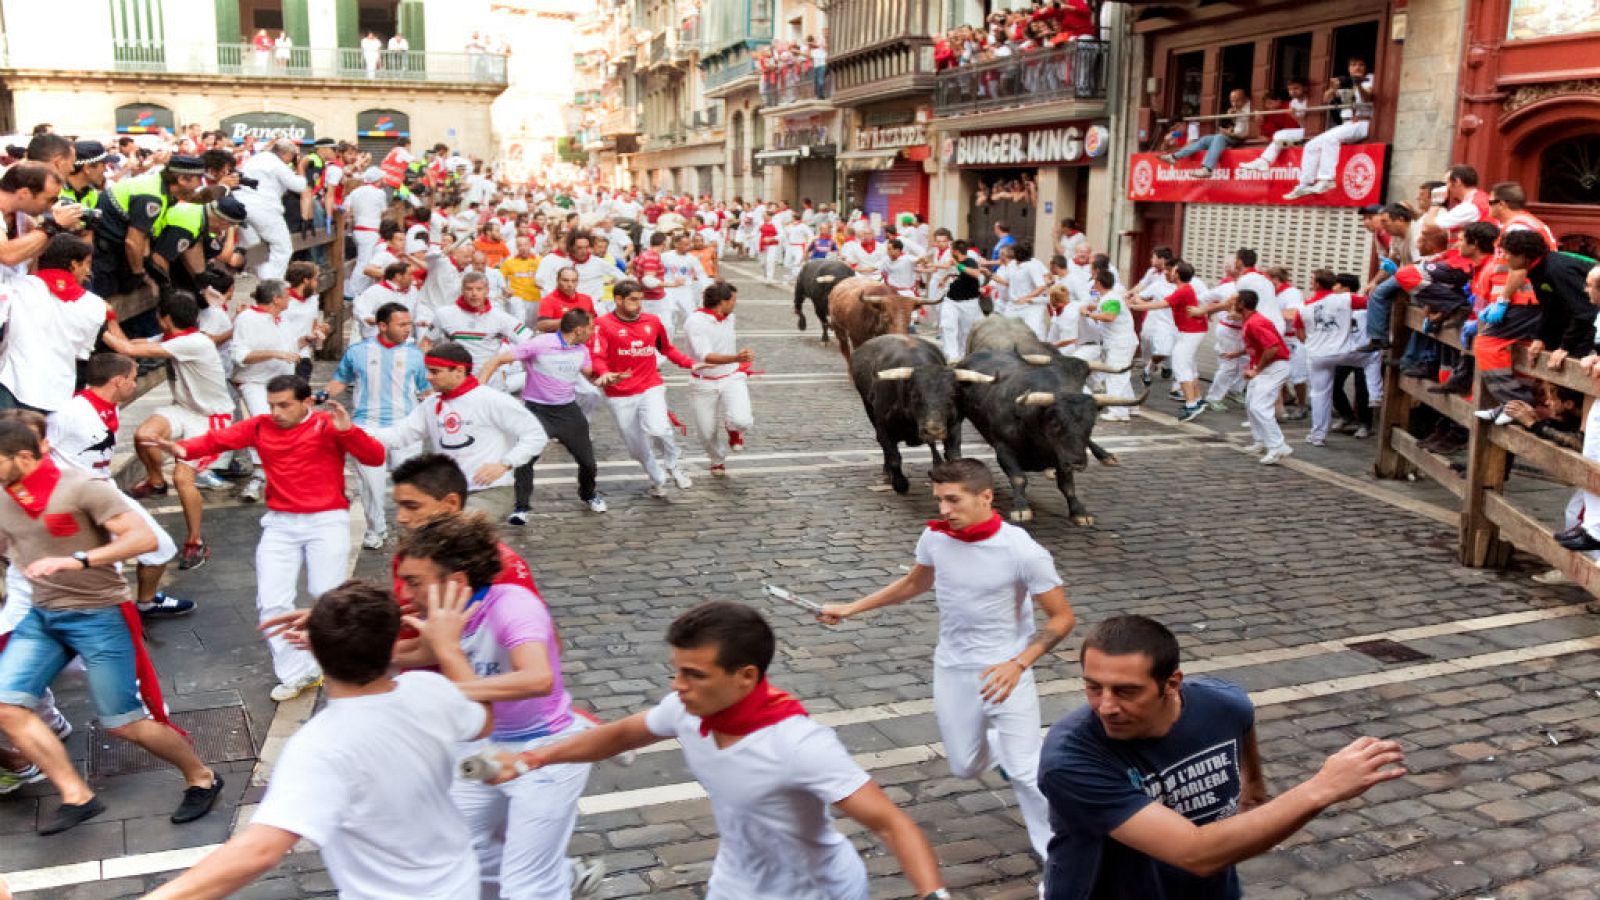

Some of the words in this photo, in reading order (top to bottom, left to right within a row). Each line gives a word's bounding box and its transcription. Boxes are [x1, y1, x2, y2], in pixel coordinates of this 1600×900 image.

[231, 123, 306, 139] Banesto
[957, 132, 1023, 165] BURGER
[1028, 127, 1079, 162] KING
